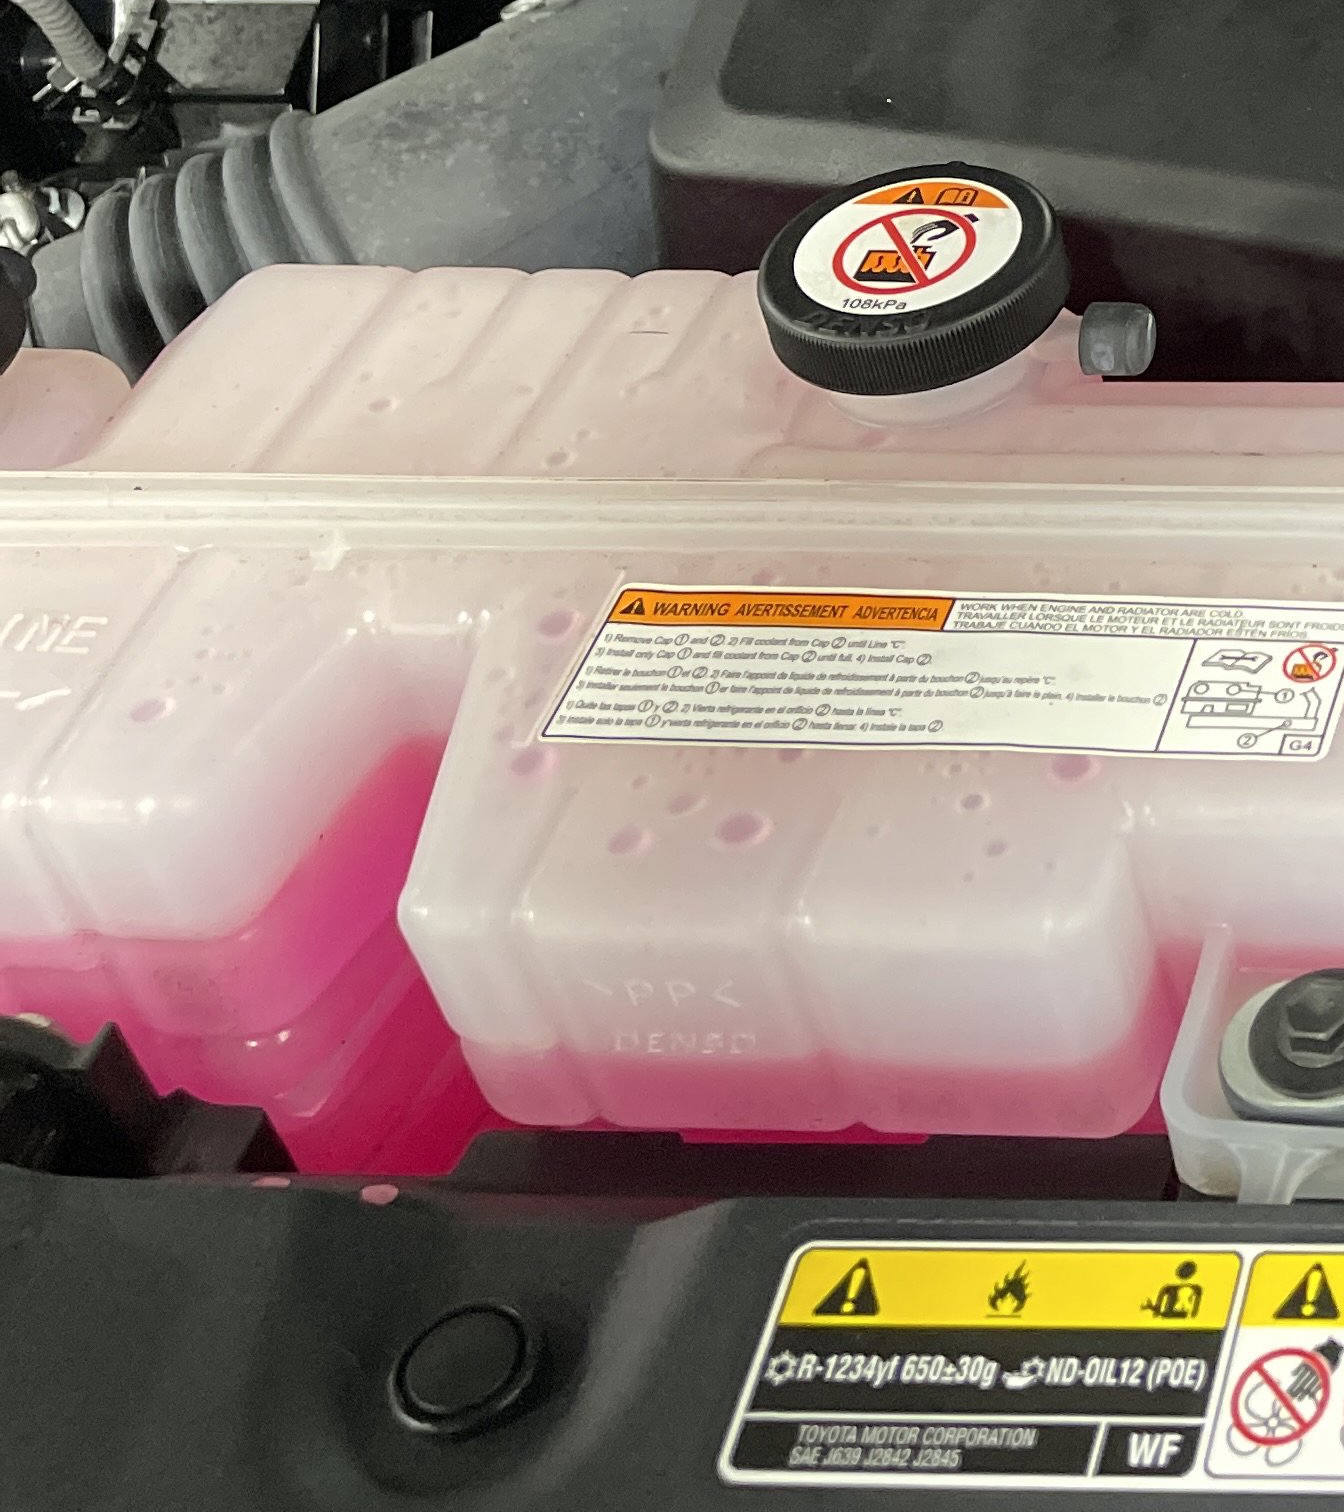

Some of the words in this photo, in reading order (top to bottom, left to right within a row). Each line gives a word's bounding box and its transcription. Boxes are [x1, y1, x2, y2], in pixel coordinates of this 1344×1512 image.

[842, 298, 907, 311] 108kPa
[653, 601, 730, 617] WARNING
[735, 603, 848, 619] AVERTISSEMENT
[853, 605, 938, 621] ADVERTENCIA
[960, 603, 998, 612] WORK
[1000, 603, 1037, 612] WHEN
[1040, 604, 1087, 613] ENGINE
[1088, 606, 1115, 615] AND
[1117, 606, 1179, 617] RADIATOR
[1180, 608, 1206, 617] ARE
[953, 621, 1006, 630] TRABAJE
[1009, 622, 1063, 631] CUANDO
[1065, 623, 1079, 632] EL
[1082, 624, 1129, 633] MOTOR
[1132, 625, 1140, 633] Y
[1141, 625, 1155, 634] EL
[1159, 626, 1223, 636] RADIADOR
[957, 612, 1026, 621] TRAVAILLER
[1028, 613, 1086, 623] LORSQUE
[1089, 614, 1105, 623] LE
[1107, 615, 1159, 625] MOTEUR
[1162, 617, 1177, 625] ET
[1179, 618, 1194, 627] LE
[1197, 618, 1265, 629] RADIATEUR
[1268, 620, 1301, 630] SONT
[1289, 740, 1312, 751] G4
[797, 1353, 900, 1388] R-1234yf
[901, 1354, 998, 1389] 650±30g
[1045, 1355, 1148, 1387] ND-OIL12
[1147, 1356, 1208, 1392] (POE)
[799, 1424, 857, 1445] TOYOTA
[861, 1425, 919, 1445] MOTOR
[922, 1426, 1037, 1448] CORPORATION
[789, 1445, 823, 1467] SAE
[823, 1446, 862, 1467] J639
[863, 1447, 912, 1467] J2842
[912, 1448, 962, 1468] J2845
[1127, 1431, 1184, 1468] WF
